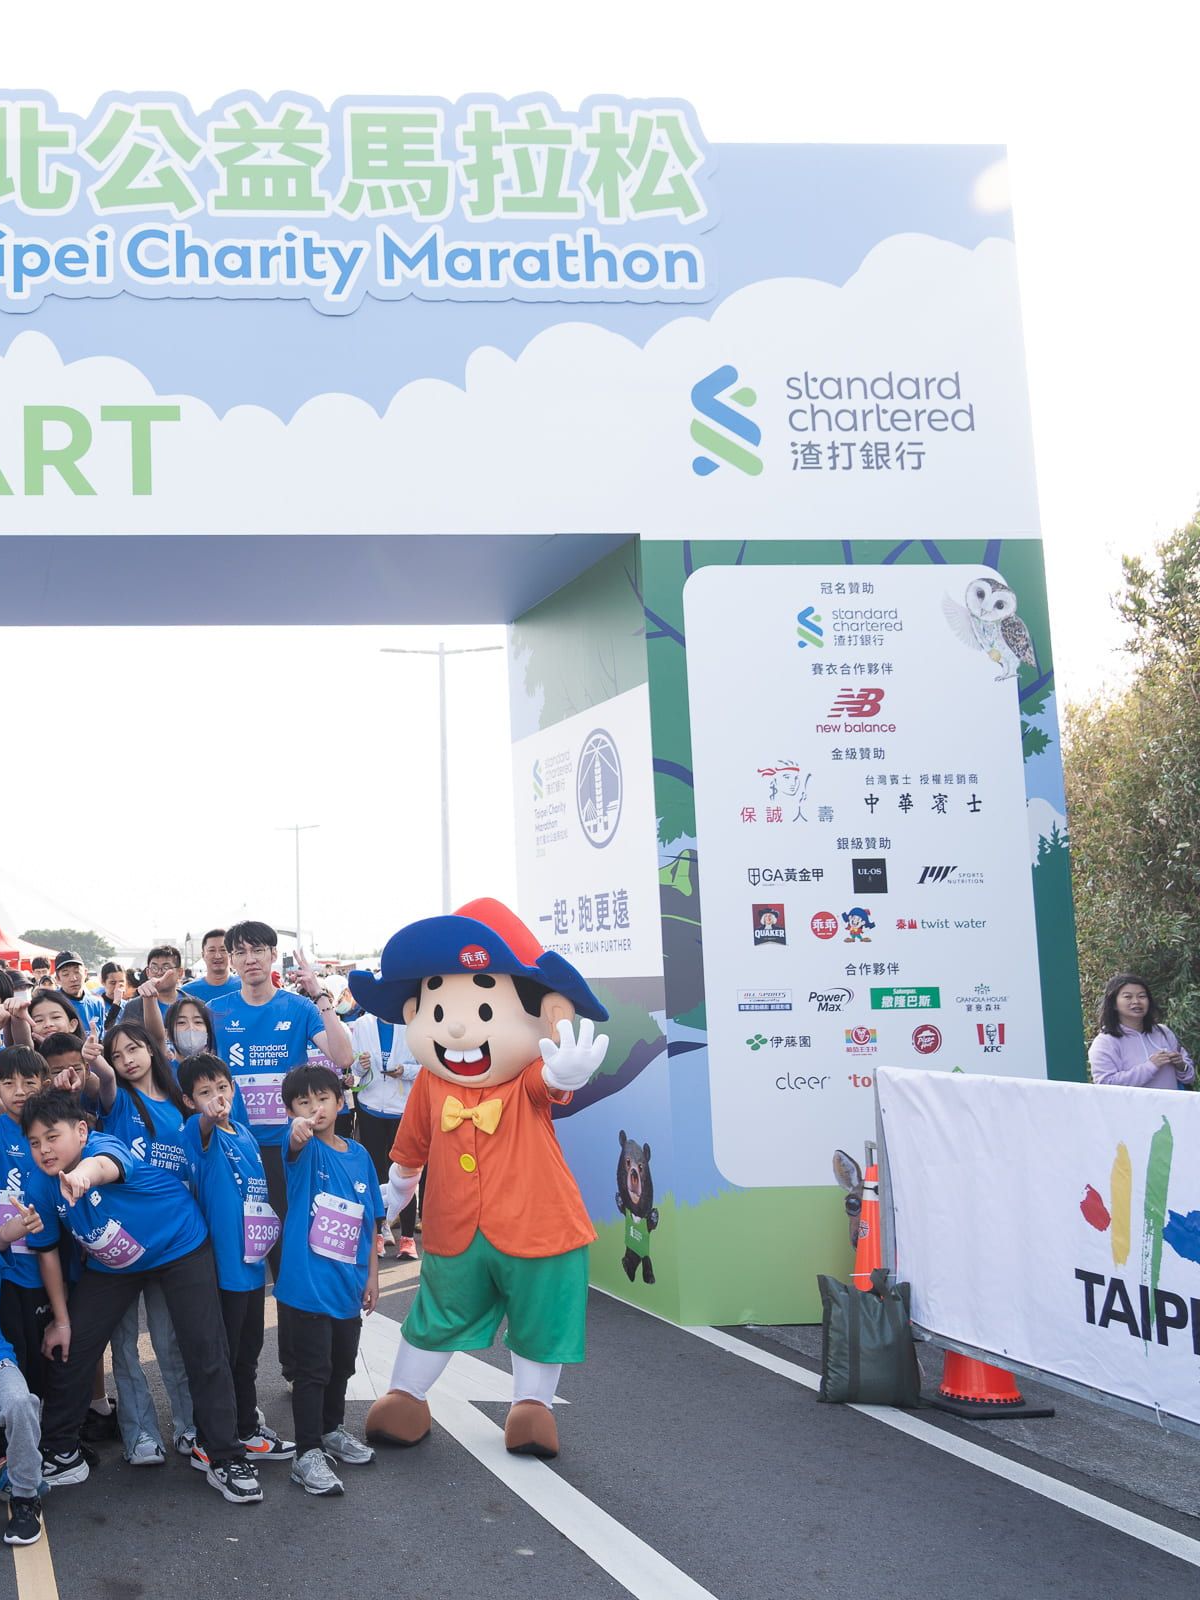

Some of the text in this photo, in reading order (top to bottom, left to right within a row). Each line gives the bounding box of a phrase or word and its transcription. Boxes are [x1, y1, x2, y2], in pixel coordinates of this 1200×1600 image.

[125, 228, 363, 295] Charity
[383, 231, 700, 285] Marathon
[785, 371, 961, 400] standard
[788, 403, 975, 432] chartered
[791, 440, 926, 470] 渣打銀行
[820, 582, 874, 594] 冠名贊助
[832, 608, 897, 620] standard
[832, 620, 903, 632] chartered
[834, 634, 884, 647] 渣打銀行
[811, 662, 894, 676] 賽衣合作夥伴
[816, 722, 896, 733] new balance
[831, 748, 885, 760] 金級贊助
[864, 793, 982, 814] 中華賓士
[740, 805, 834, 823] 保誠人壽
[836, 837, 891, 850] 銀級贊助
[812, 918, 837, 931] 乖乖
[921, 918, 950, 929] twist
[954, 918, 987, 929] water
[754, 929, 785, 938] QUAKER
[461, 951, 487, 965] 乖乖
[845, 963, 900, 976] 合作夥伴
[808, 991, 846, 1003] Power
[817, 1003, 841, 1012] Max
[249, 1044, 286, 1052] standard
[770, 1035, 811, 1048] 伊藤園
[776, 1072, 827, 1090] cleer
[852, 1074, 872, 1088] to
[247, 1224, 280, 1241] 32396
